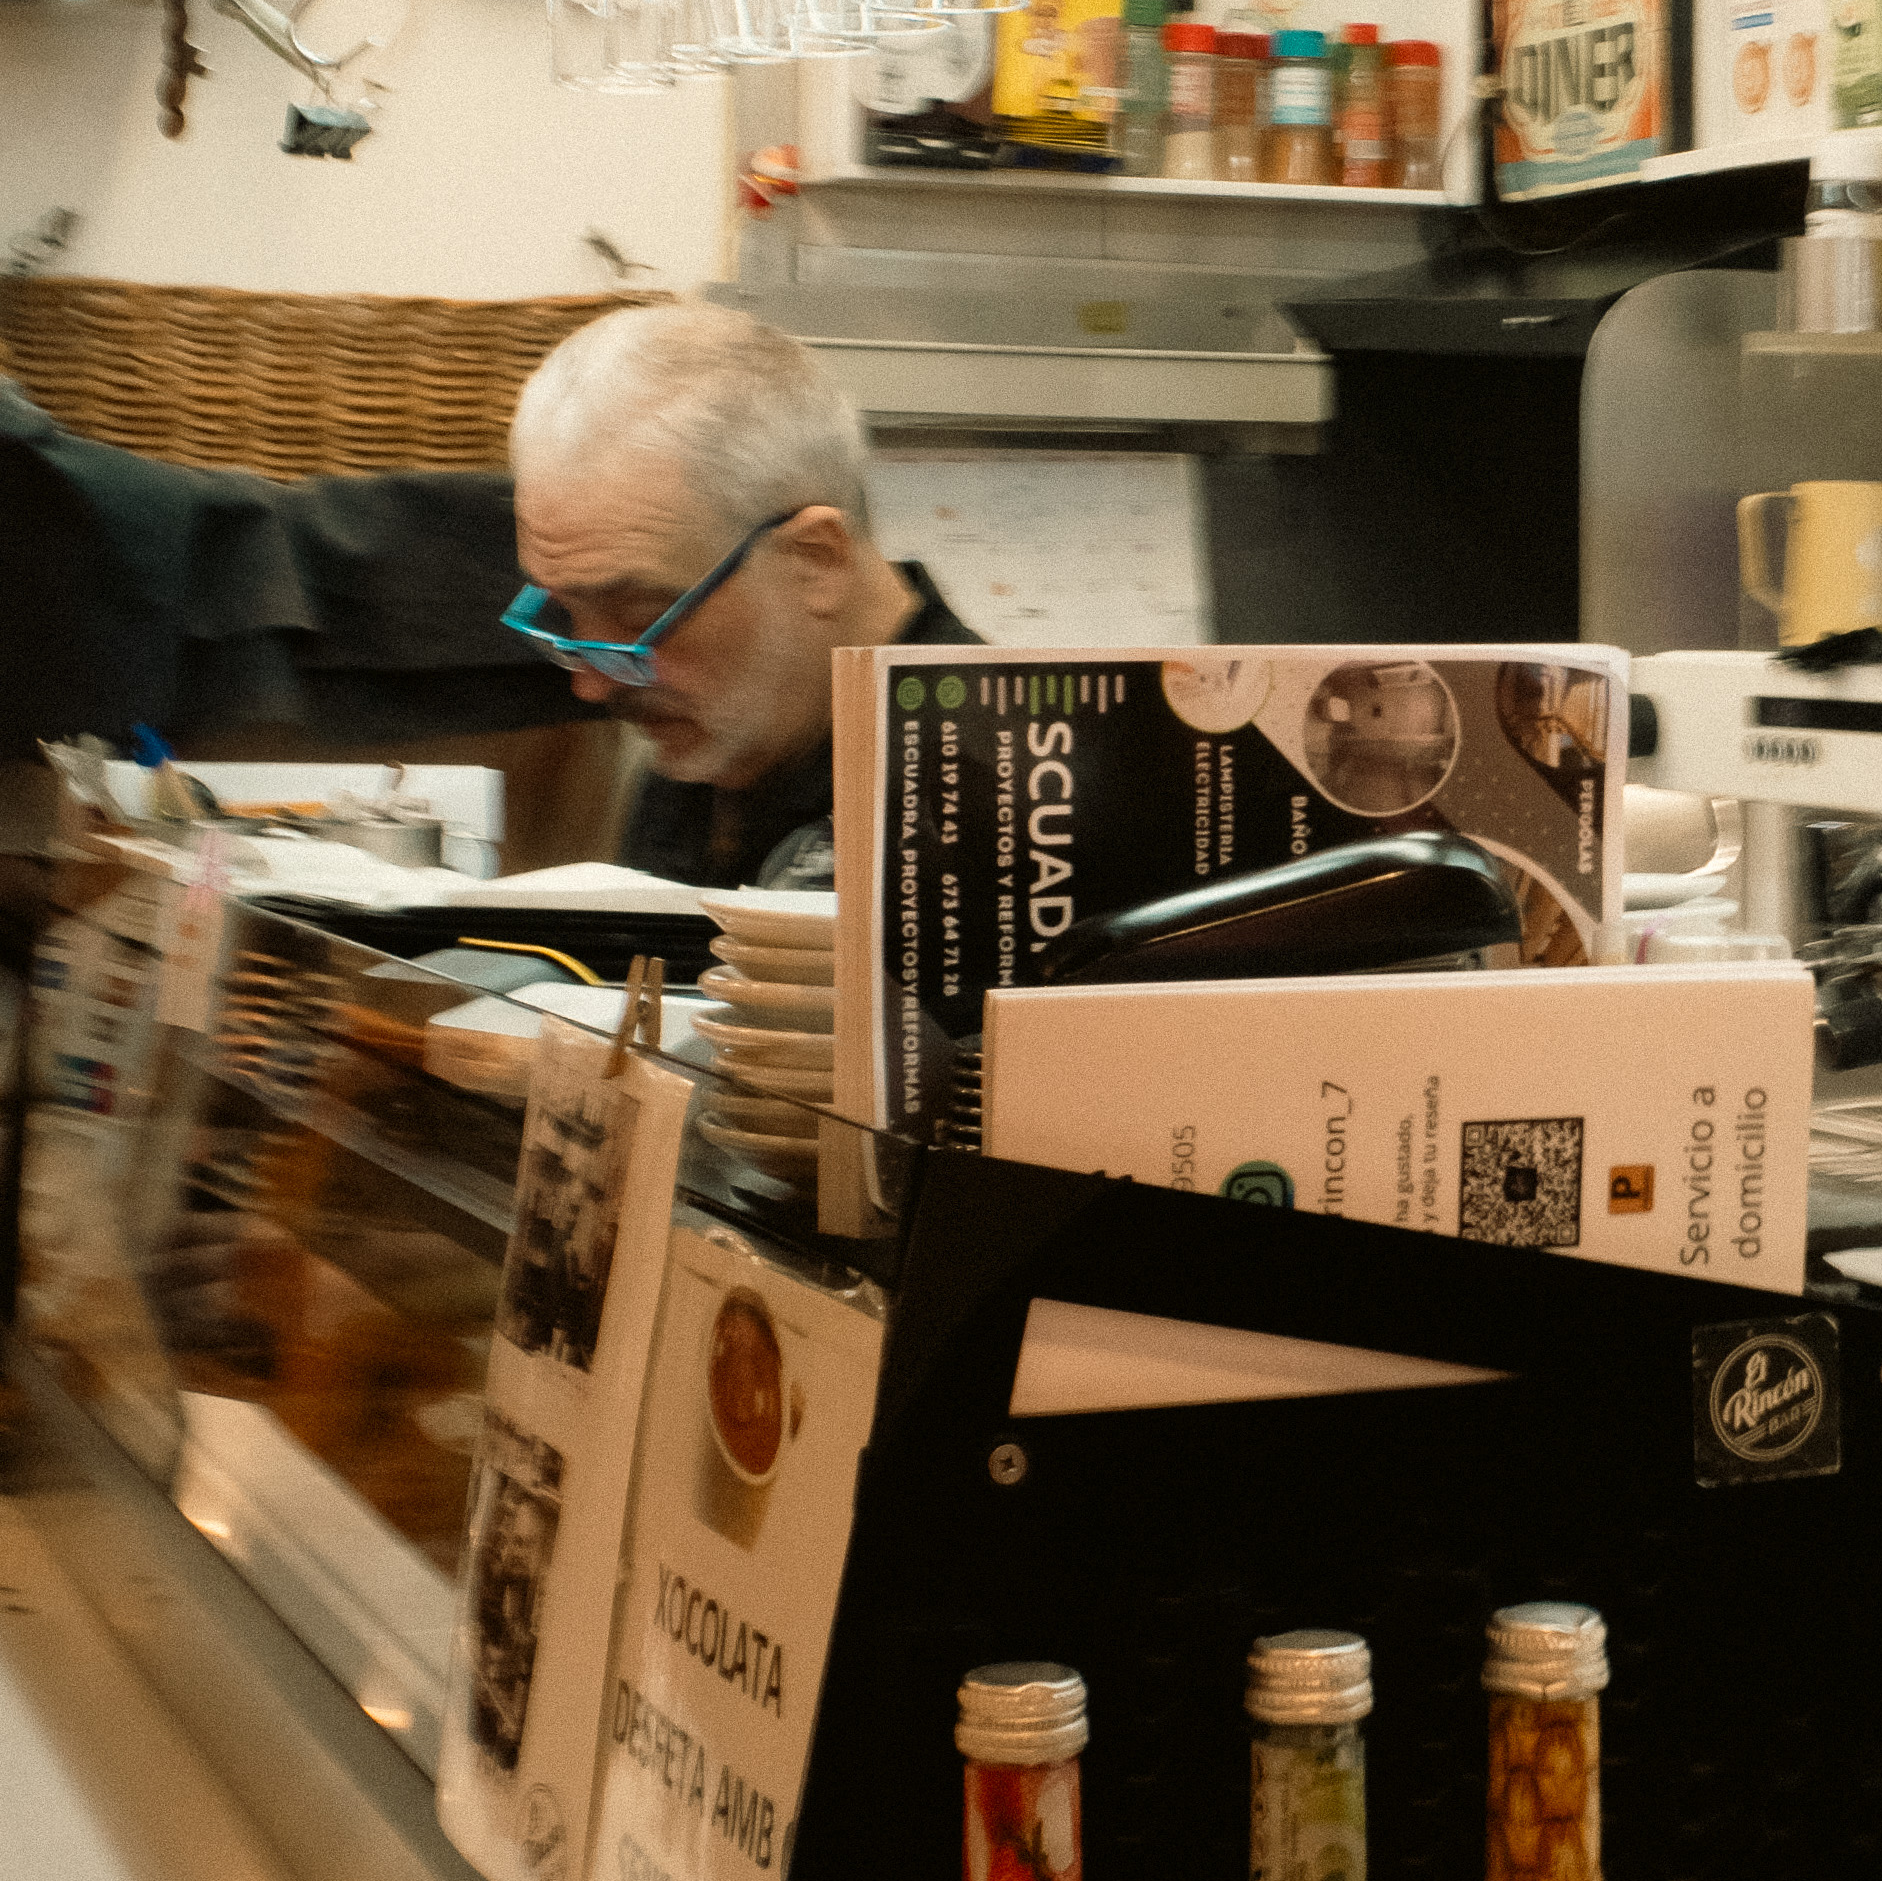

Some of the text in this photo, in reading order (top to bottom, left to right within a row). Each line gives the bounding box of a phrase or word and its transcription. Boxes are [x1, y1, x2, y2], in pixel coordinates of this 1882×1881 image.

[1511, 23, 1638, 121] DINER
[941, 721, 958, 757] 610
[942, 763, 959, 786] 19
[942, 791, 959, 814] 74
[997, 731, 1015, 867] PROYECTOS
[941, 821, 958, 844] 43
[1195, 741, 1211, 876] ELECTRICIDAD
[1219, 744, 1234, 866] LAMPISTERIA
[1291, 795, 1312, 855] BAÑO
[1027, 721, 1074, 953] SCUAD
[942, 873, 960, 909] 673
[998, 874, 1014, 888] Y
[942, 916, 960, 941] 64
[943, 946, 960, 967] 71
[1423, 1074, 1441, 1139] reseña
[1422, 1143, 1438, 1164] tu
[1679, 1086, 1715, 1266] Servicio a
[1730, 1087, 1767, 1259] domicilio
[1611, 1175, 1641, 1199] P
[653, 1564, 784, 1719] XOCOLATA
[711, 1763, 775, 1871] AMB
